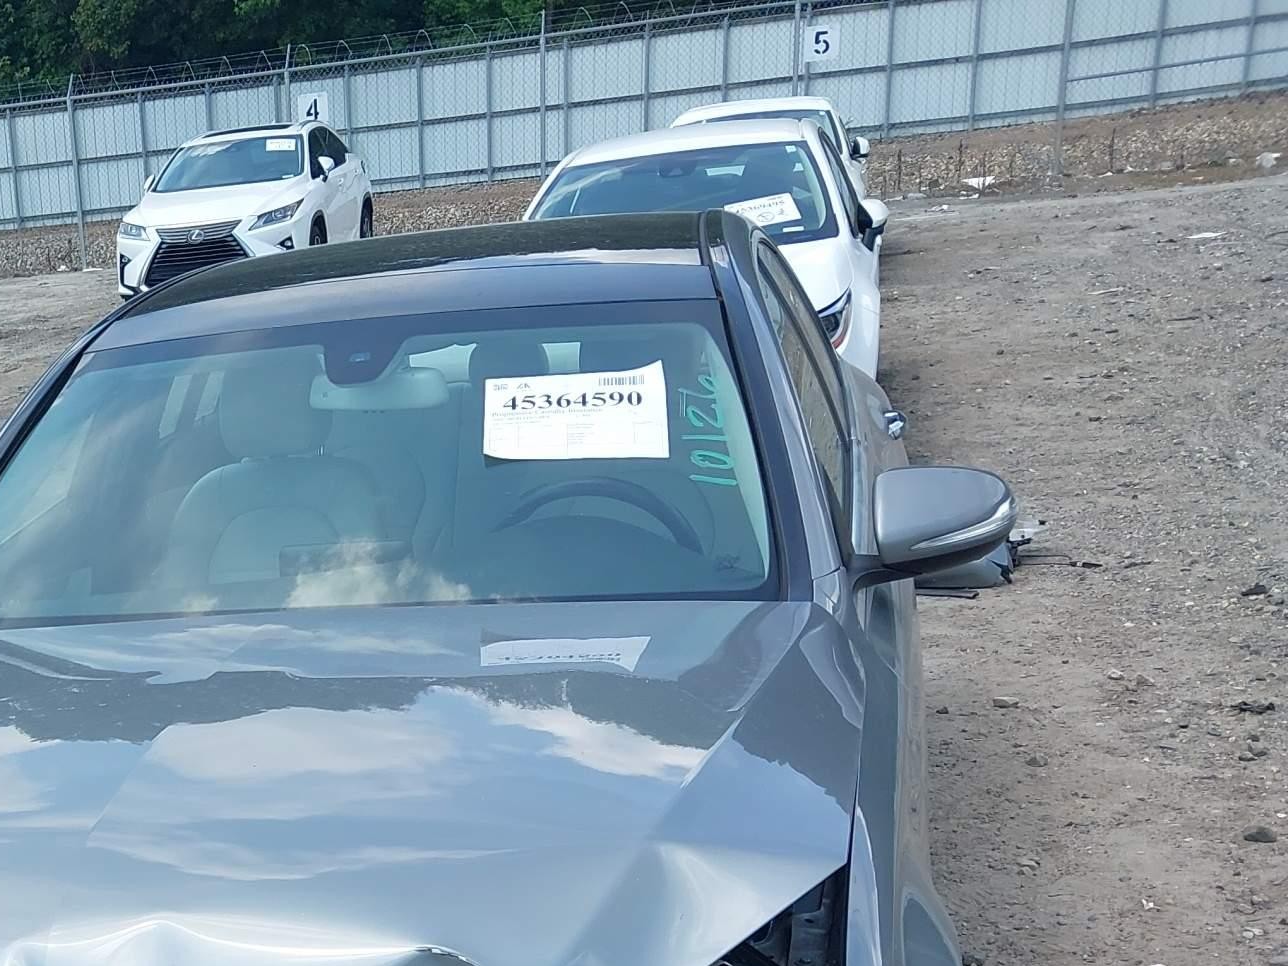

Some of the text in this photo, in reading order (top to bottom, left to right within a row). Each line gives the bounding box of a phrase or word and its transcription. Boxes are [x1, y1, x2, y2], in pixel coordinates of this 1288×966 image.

[814, 31, 829, 54] 5
[306, 98, 319, 120] 4
[503, 390, 643, 411] 45364590
